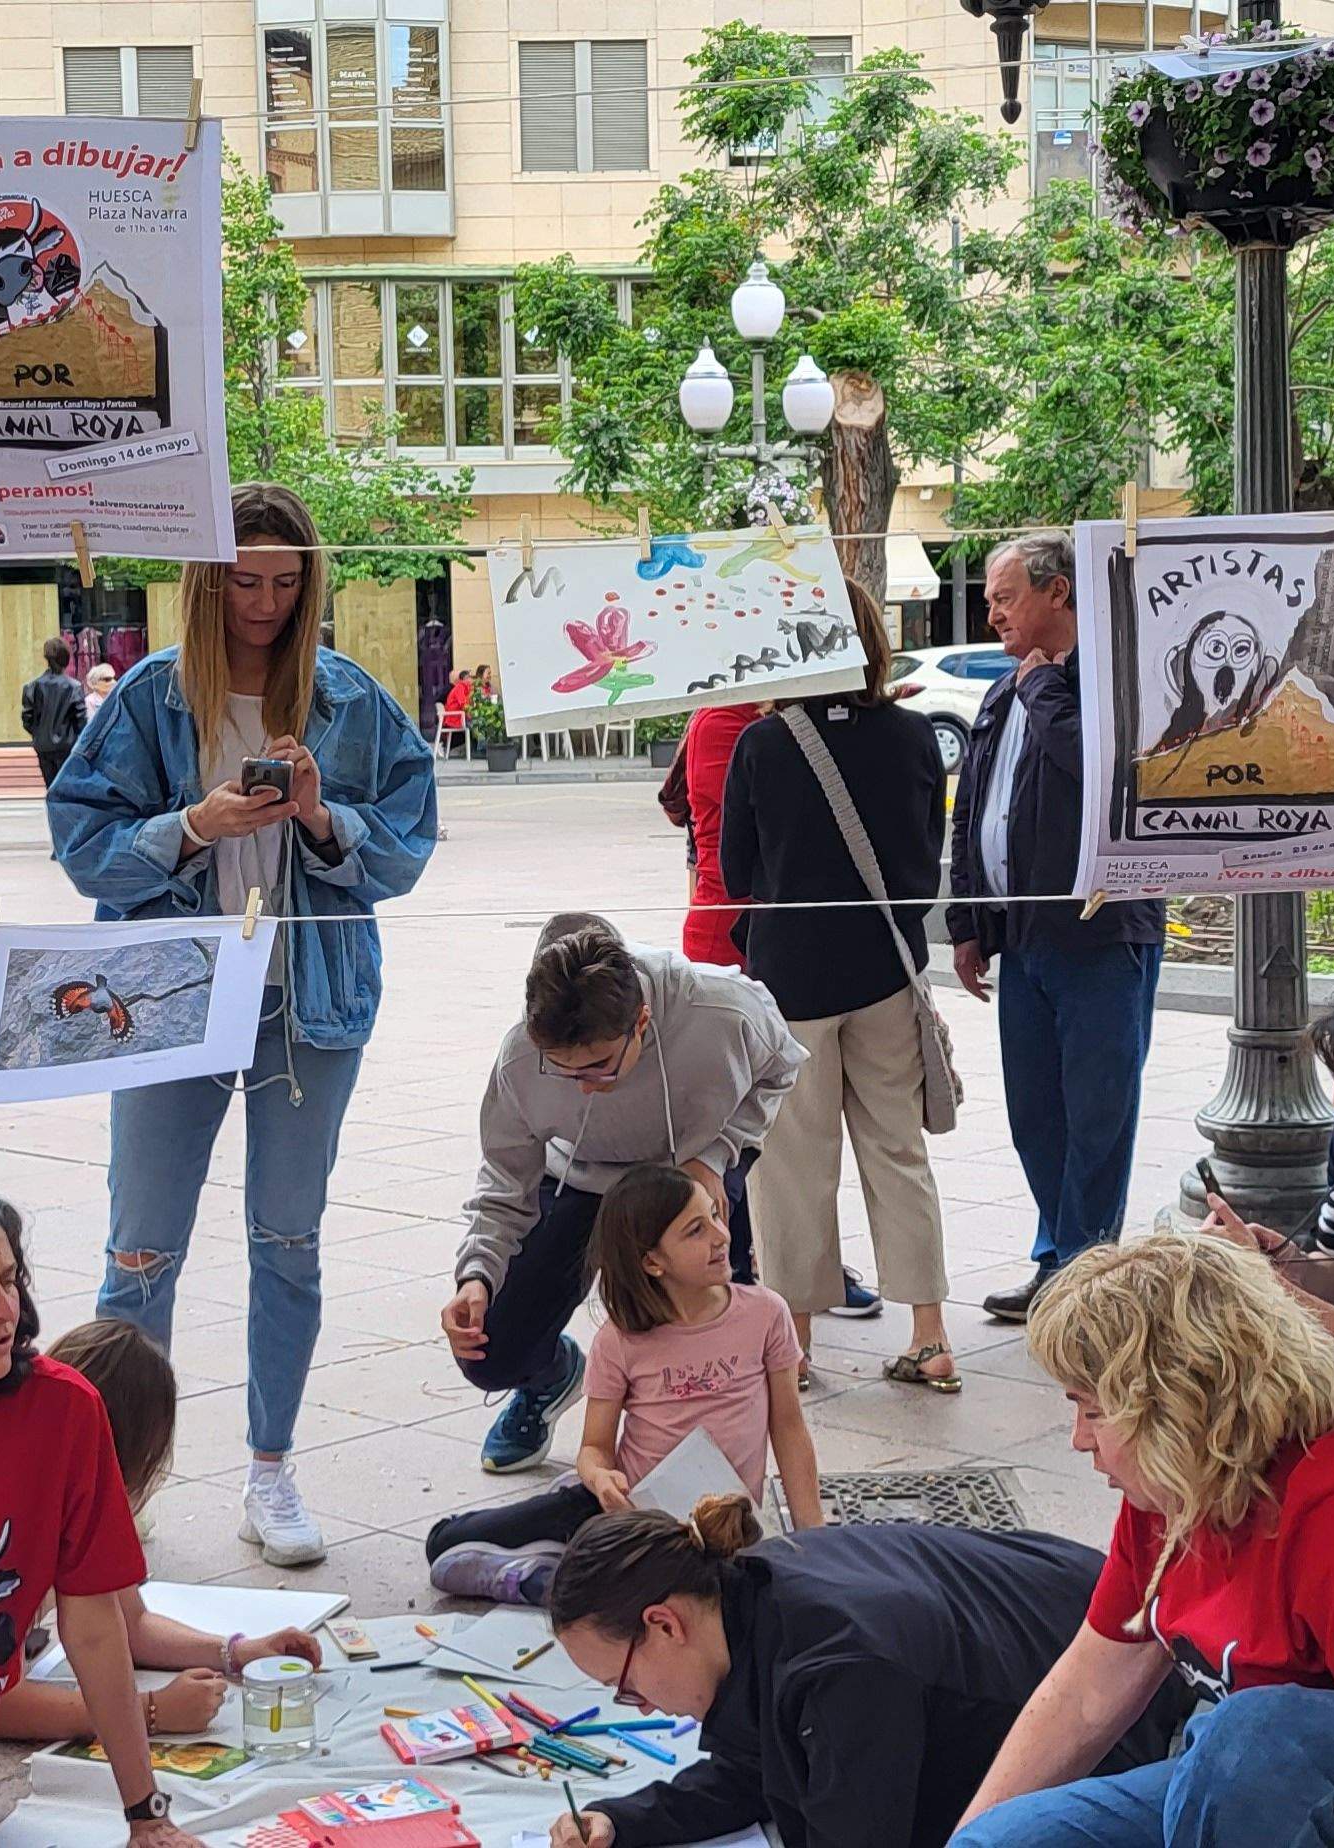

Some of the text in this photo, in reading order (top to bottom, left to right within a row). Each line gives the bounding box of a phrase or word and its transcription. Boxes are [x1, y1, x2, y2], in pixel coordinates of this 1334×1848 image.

[13, 148, 32, 167] a
[42, 140, 189, 183] dibujar!
[88, 189, 153, 203] HUESCA
[88, 206, 188, 221] Plaza Navarra
[114, 224, 126, 234] de
[150, 226, 157, 234] a
[13, 363, 75, 388] POR
[25, 400, 37, 409] del
[63, 400, 83, 409] Canal
[83, 400, 101, 410] Roya
[106, 400, 137, 409] Partacua
[69, 411, 146, 441] ROYA
[58, 437, 191, 474] Domingo 14 de mayo
[88, 499, 186, 512] #salvemoscanalroya
[1147, 549, 1305, 617] ARTISTAS
[1205, 763, 1265, 787] POR
[1142, 808, 1332, 832] CANAL ROYA
[1107, 861, 1169, 870] HUESCA
[1106, 870, 1209, 880] Plaza Zaragoza
[1217, 869, 1265, 881] ¡Ven
[1270, 871, 1283, 879] a
